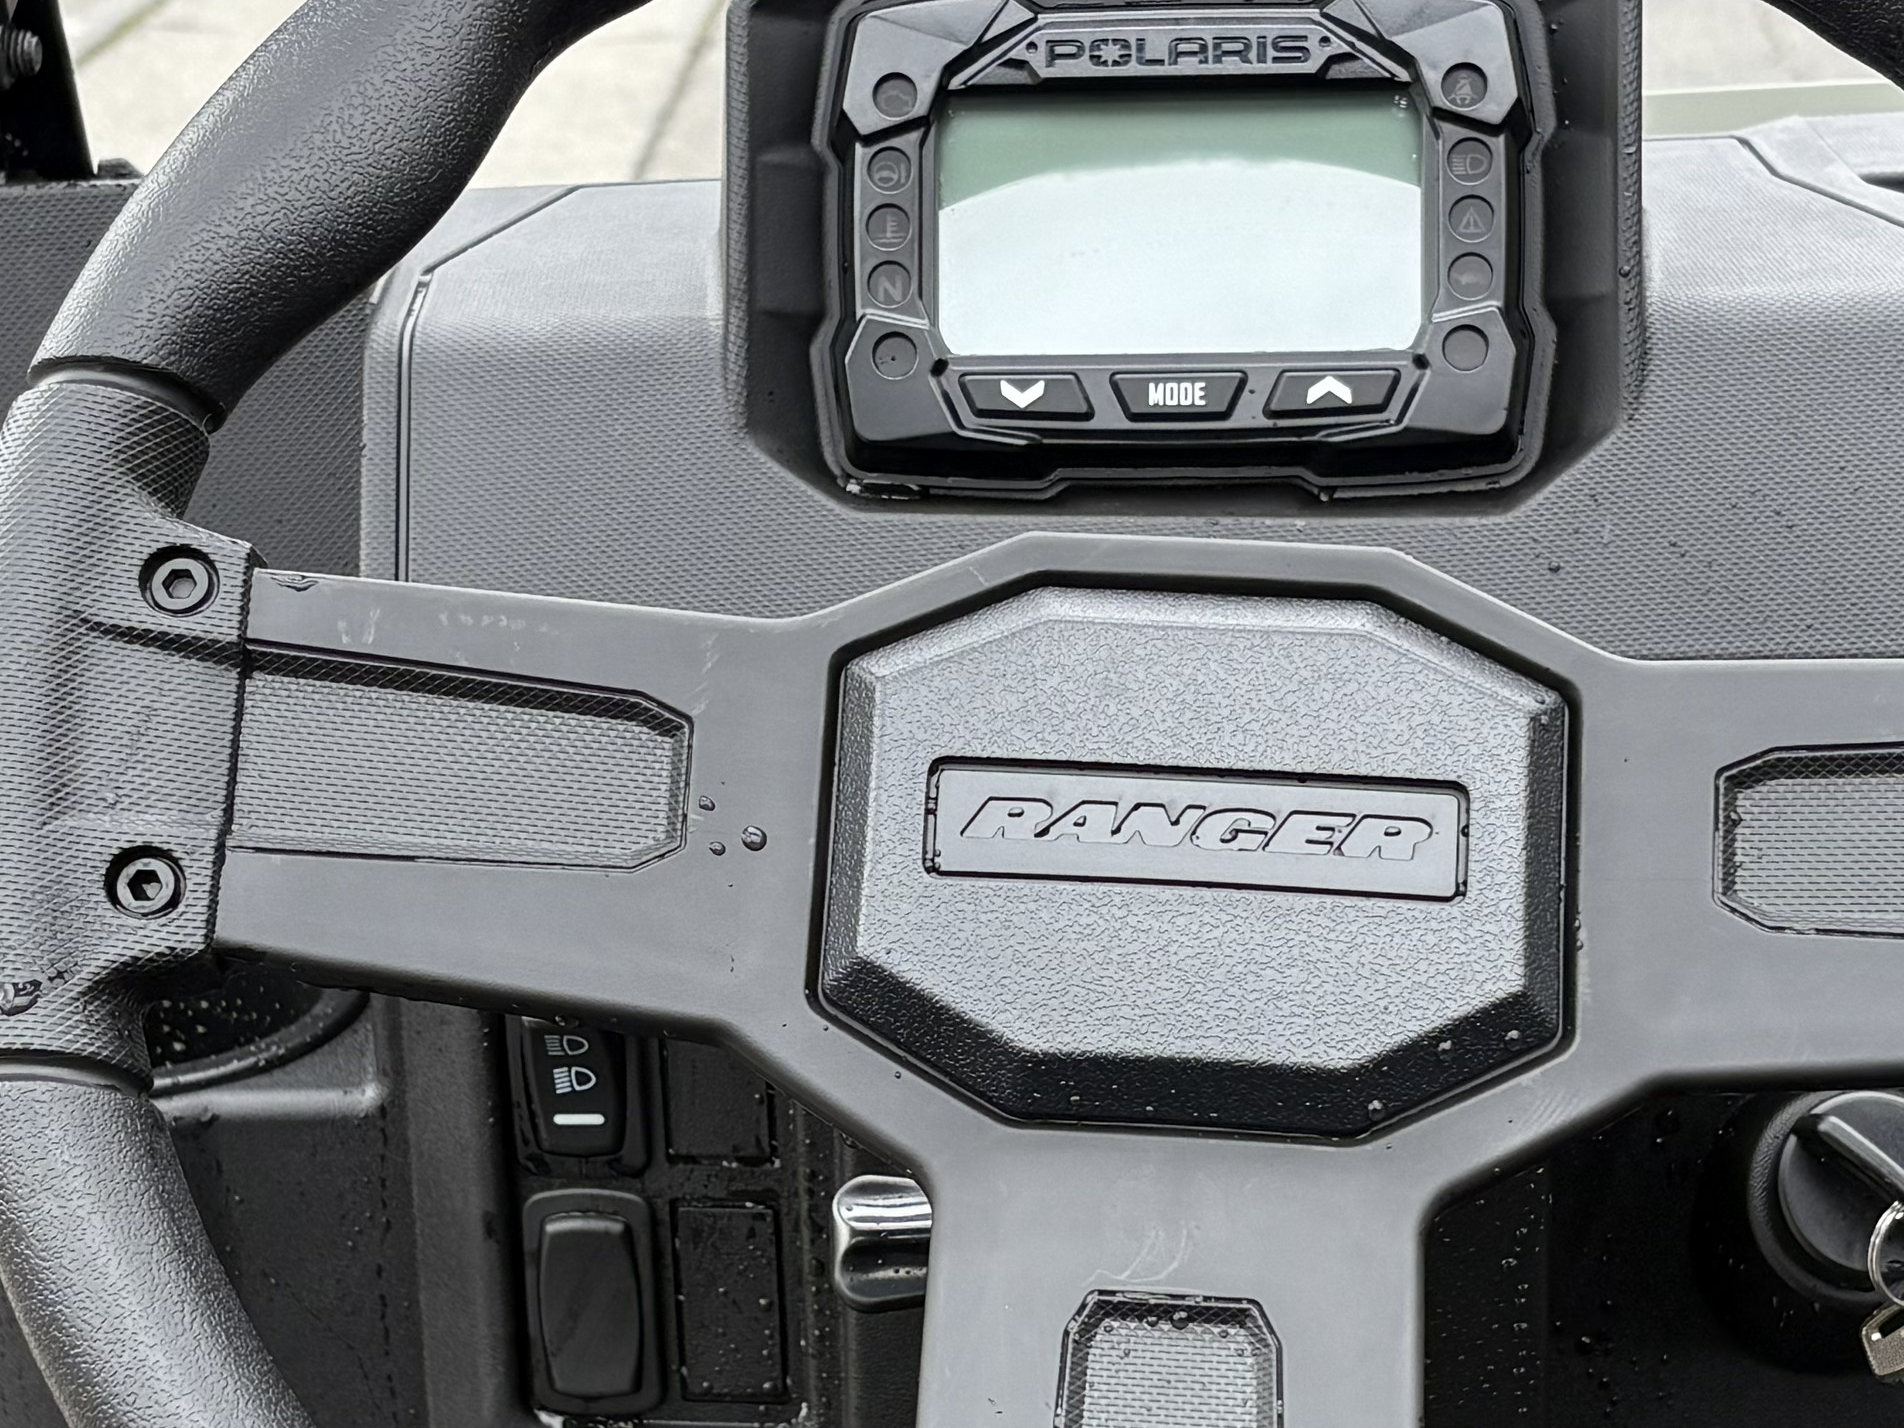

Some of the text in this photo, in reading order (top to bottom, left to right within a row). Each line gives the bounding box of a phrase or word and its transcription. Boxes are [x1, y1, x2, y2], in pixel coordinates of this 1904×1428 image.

[1044, 35, 1312, 68] POLARIS
[1148, 381, 1207, 406] MODE
[960, 796, 1433, 861] RANGER
